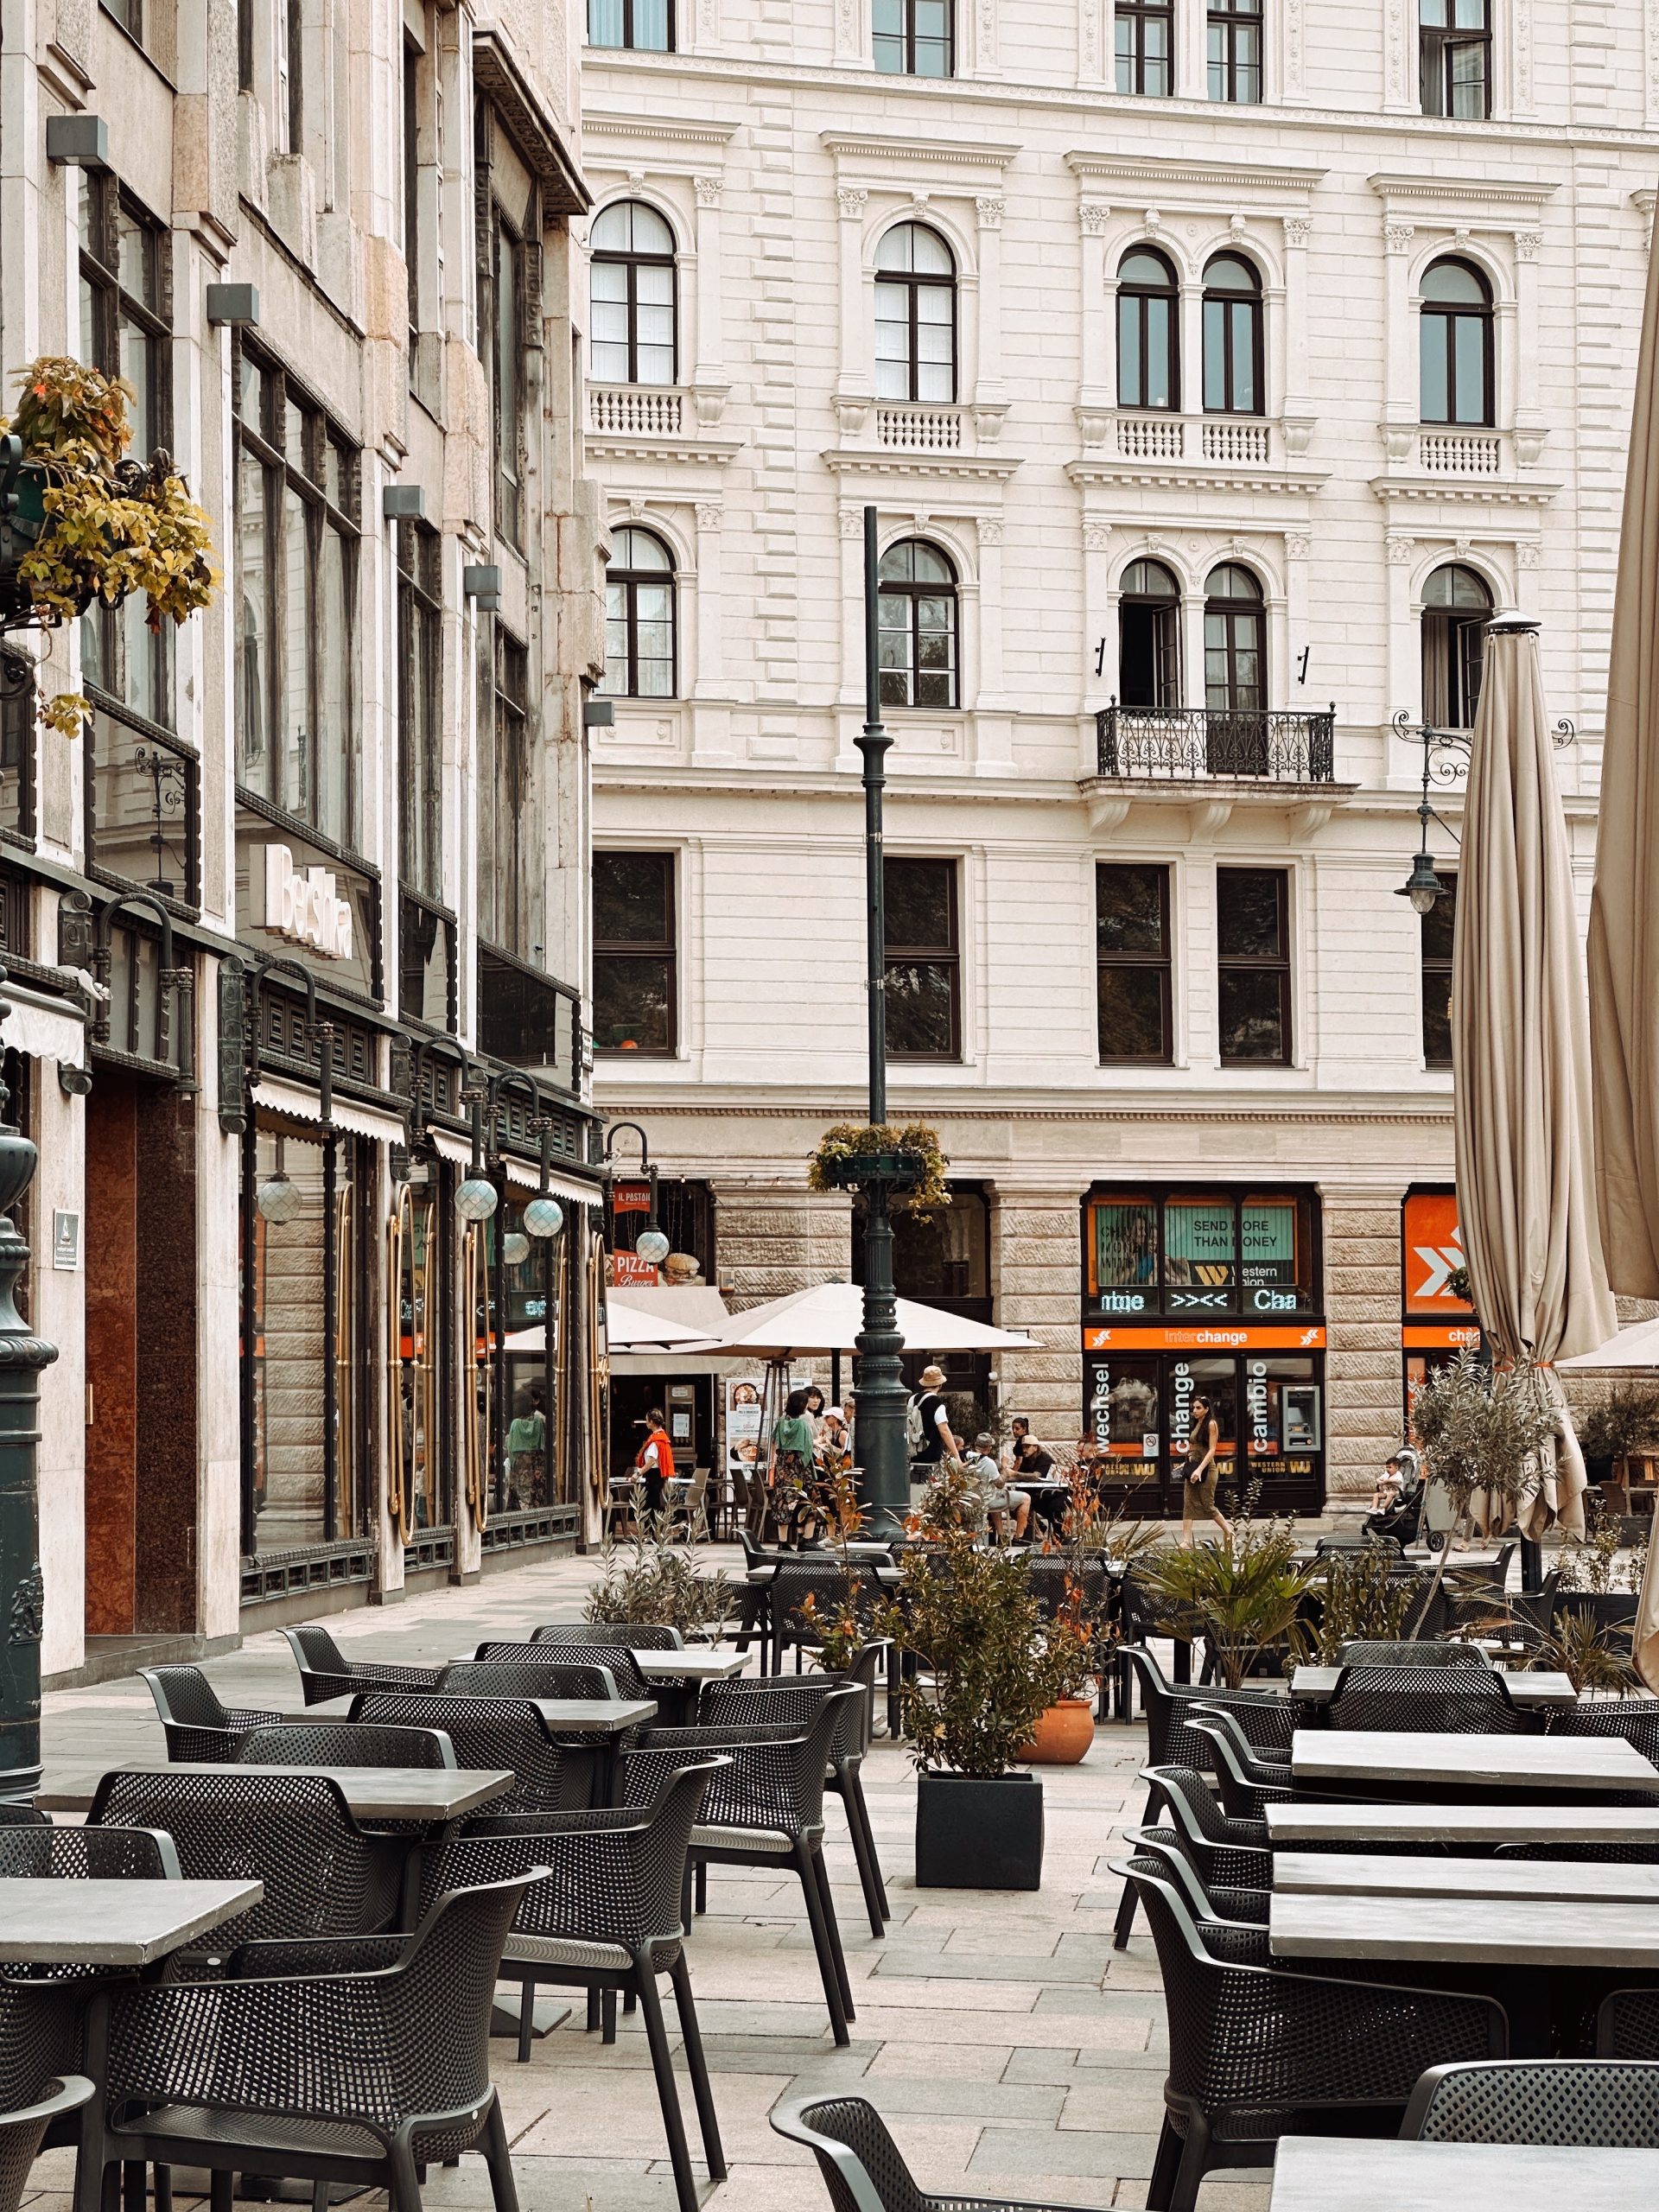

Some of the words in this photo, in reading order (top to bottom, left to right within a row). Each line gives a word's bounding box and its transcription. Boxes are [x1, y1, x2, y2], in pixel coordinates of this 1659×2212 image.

[618, 1192, 625, 1201] IL
[1194, 1220, 1228, 1231] SEND
[1194, 1236, 1227, 1247] THAN
[1091, 1363, 1109, 1453] wechsel
[1171, 1362, 1194, 1452] change
[1249, 1362, 1268, 1452] cambio
